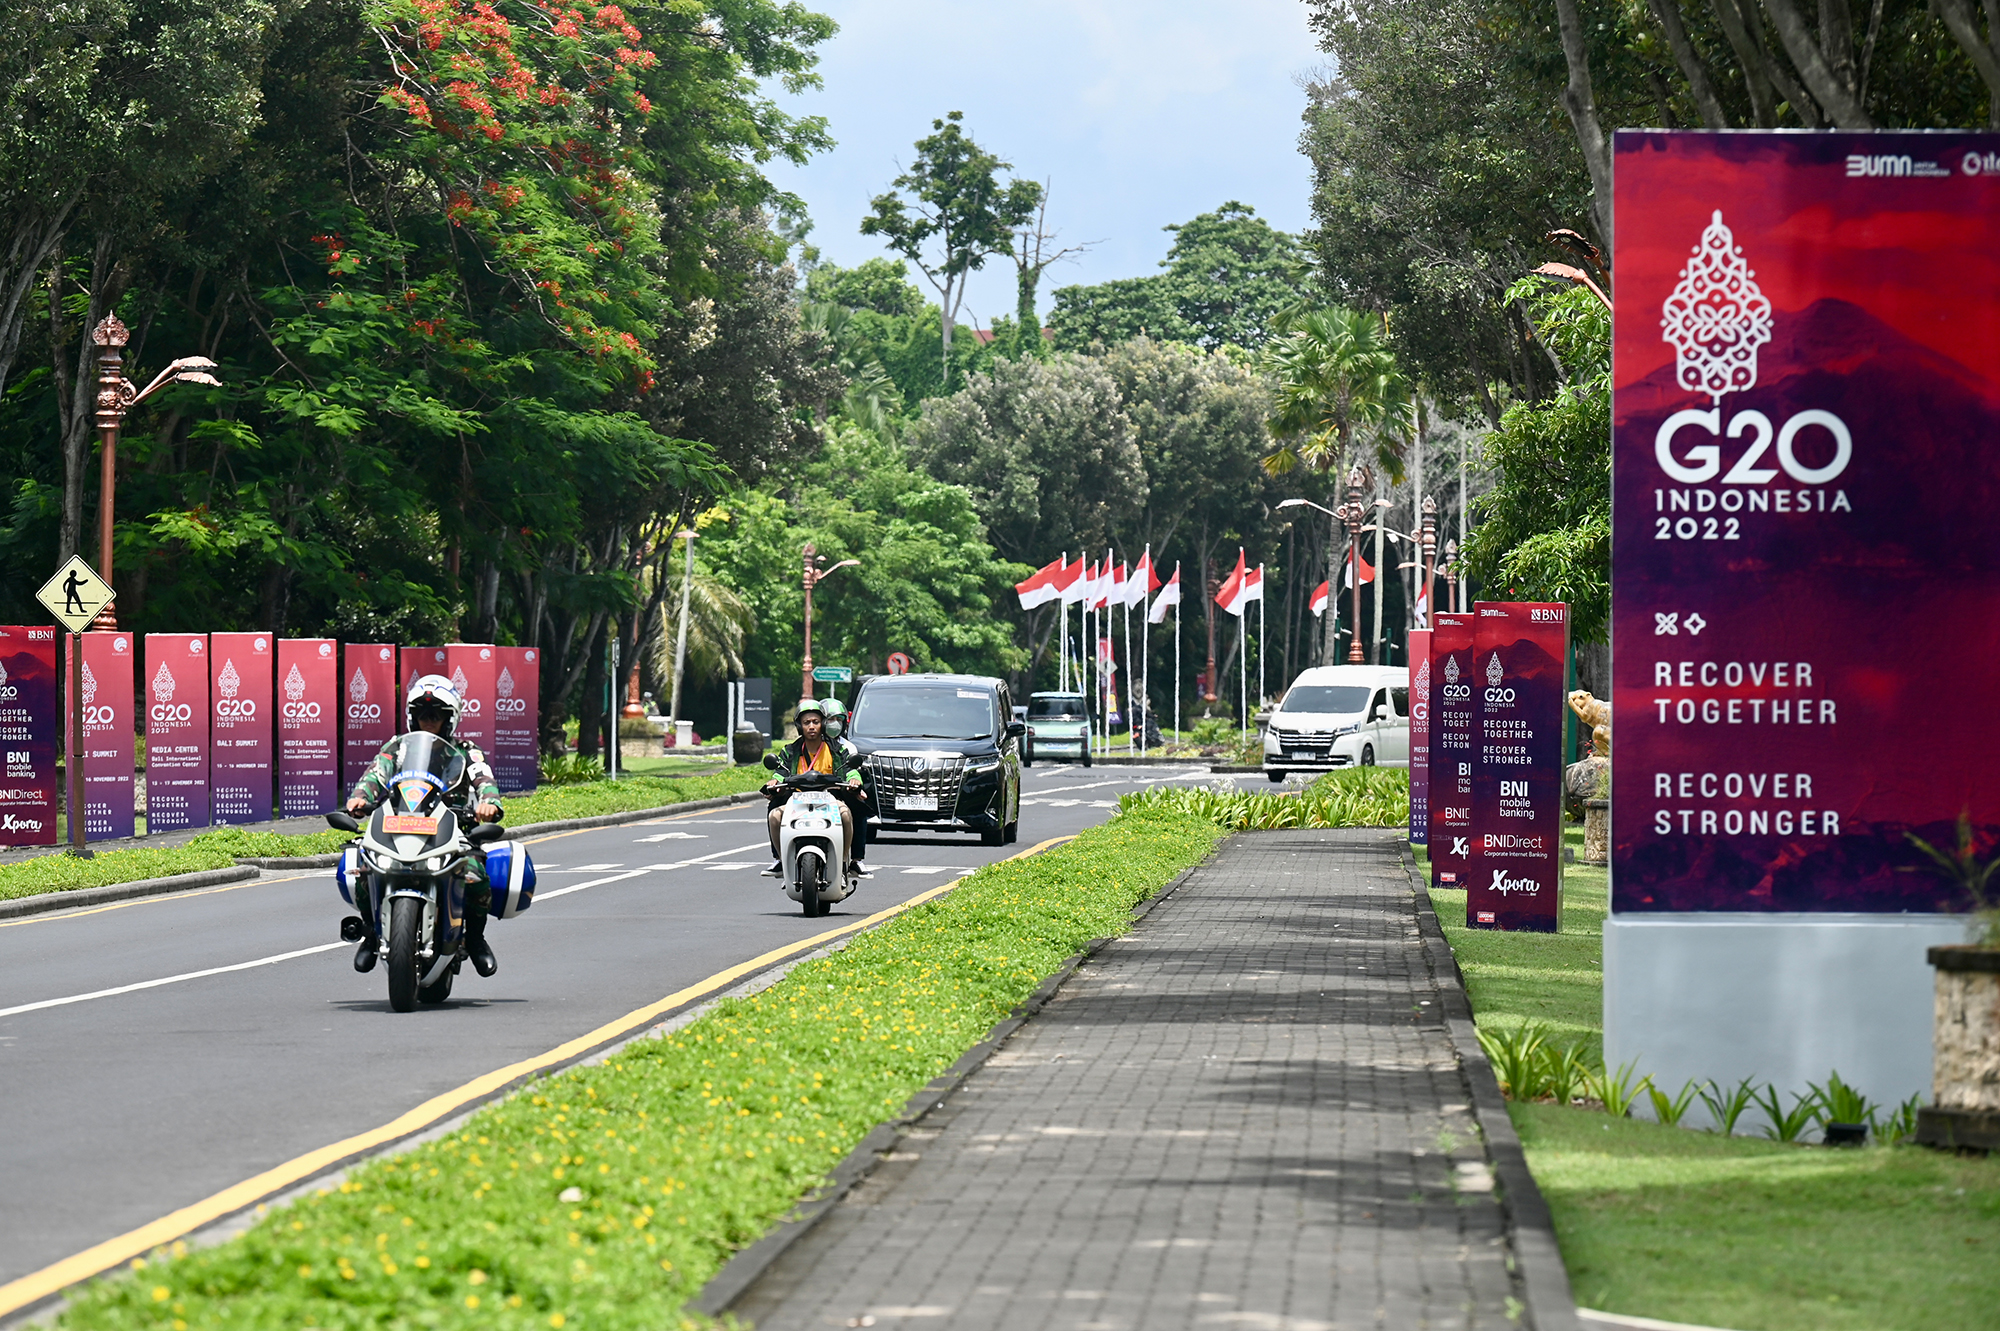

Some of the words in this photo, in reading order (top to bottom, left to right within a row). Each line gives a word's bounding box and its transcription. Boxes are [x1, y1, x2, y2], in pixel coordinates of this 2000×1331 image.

[1655, 408, 1852, 484] G20
[1655, 490, 1852, 513] INDONESIA
[1655, 518, 1740, 539] 2022
[1543, 609, 1563, 620] BNI
[37, 630, 53, 639] BNI
[1655, 662, 1812, 686] RECOVER
[0, 686, 17, 697] 20
[1443, 685, 1470, 697] G20
[1484, 688, 1515, 702] G20
[217, 699, 256, 716] G20
[283, 702, 320, 717] G20
[348, 704, 381, 718] G20
[461, 699, 480, 712] 20
[496, 698, 526, 712] G20
[1654, 699, 1836, 724] TOGETHER
[71, 706, 114, 724] 20
[151, 704, 191, 721] G20
[1484, 720, 1526, 728] RECOVER
[1484, 730, 1533, 738] TOGETHER
[1483, 746, 1526, 754] RECOVER
[7, 752, 30, 763] BNI
[1483, 756, 1532, 764] STRONGER
[7, 771, 35, 779] banking
[389, 771, 412, 786] POLISI
[414, 771, 444, 788] MILITER
[1501, 781, 1528, 796] BNI
[1655, 773, 1812, 798] RECOVER
[1500, 798, 1530, 807] mobile
[1500, 808, 1534, 820] banking
[1, 814, 42, 834] Xpora
[1654, 810, 1839, 835] STRONGER
[1484, 834, 1542, 848] BNIDirect
[1488, 870, 1540, 896] Xpora
